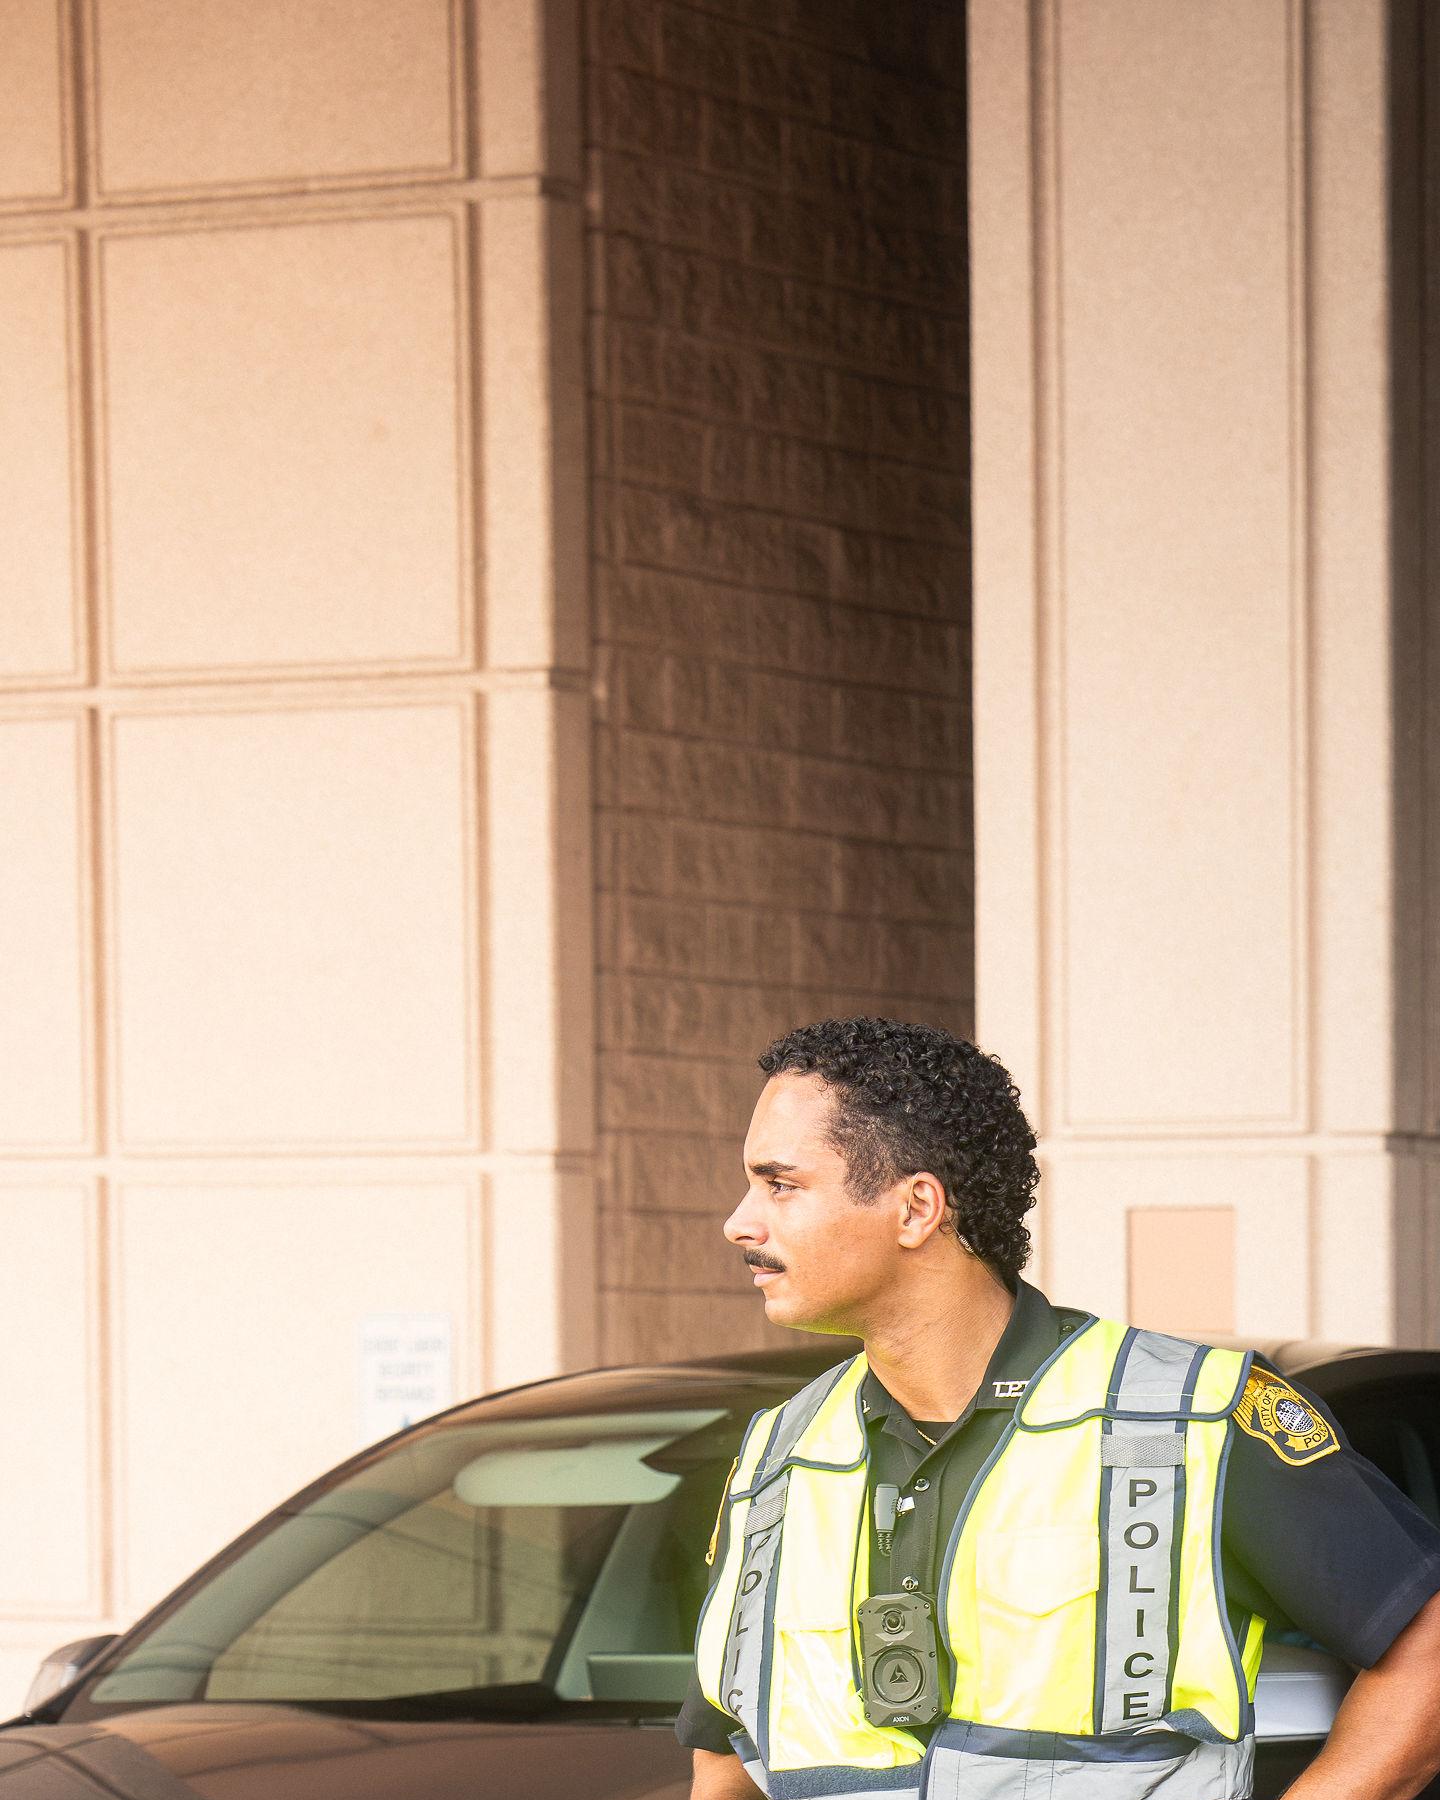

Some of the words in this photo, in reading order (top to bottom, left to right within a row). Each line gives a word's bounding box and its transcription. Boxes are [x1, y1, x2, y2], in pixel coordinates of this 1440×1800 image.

[1261, 1405, 1273, 1427] CITY
[1262, 1393, 1272, 1405] OF
[727, 1533, 772, 1716] POLIC
[1122, 1478, 1159, 1721] POLICE
